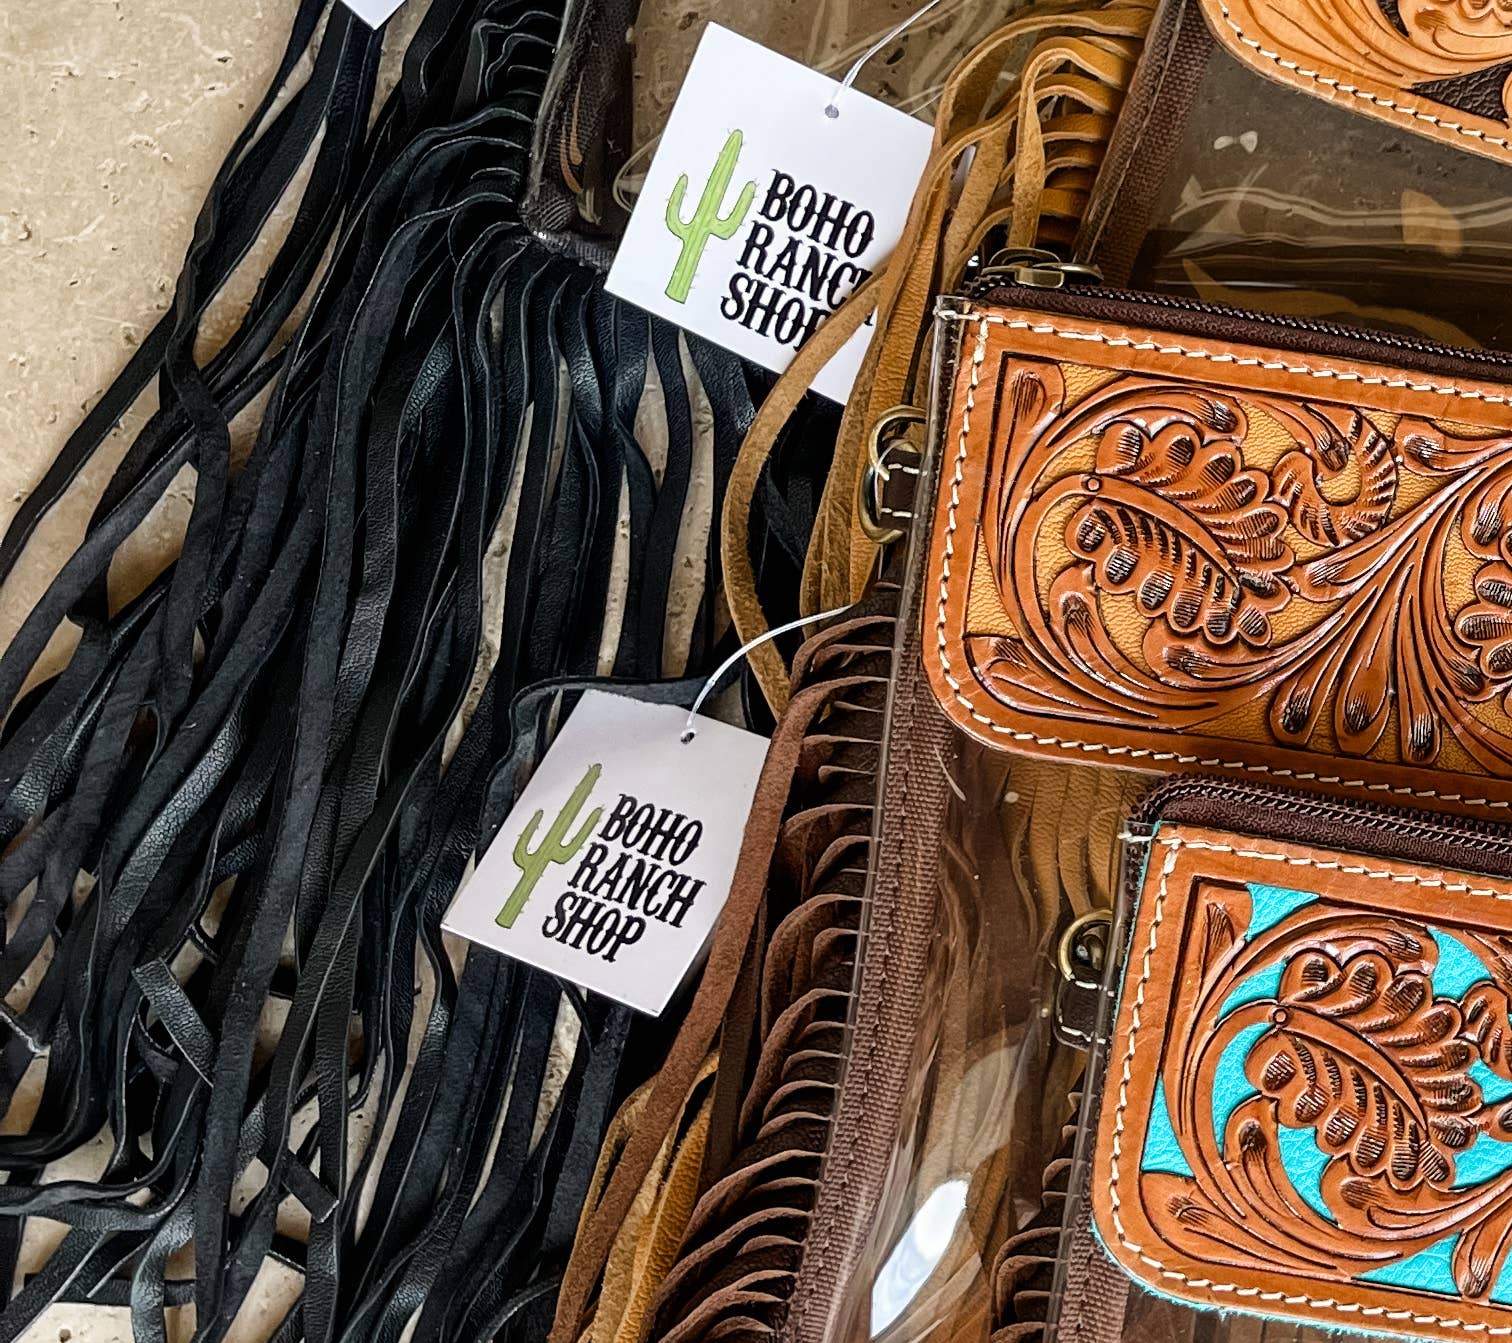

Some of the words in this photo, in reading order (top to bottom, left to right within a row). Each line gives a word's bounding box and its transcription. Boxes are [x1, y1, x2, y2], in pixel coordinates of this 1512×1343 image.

[759, 169, 875, 258] BOHO
[736, 221, 874, 326] RANC
[597, 793, 703, 866] BOHO
[541, 891, 647, 963] SHOP
[567, 842, 707, 928] RANCH
